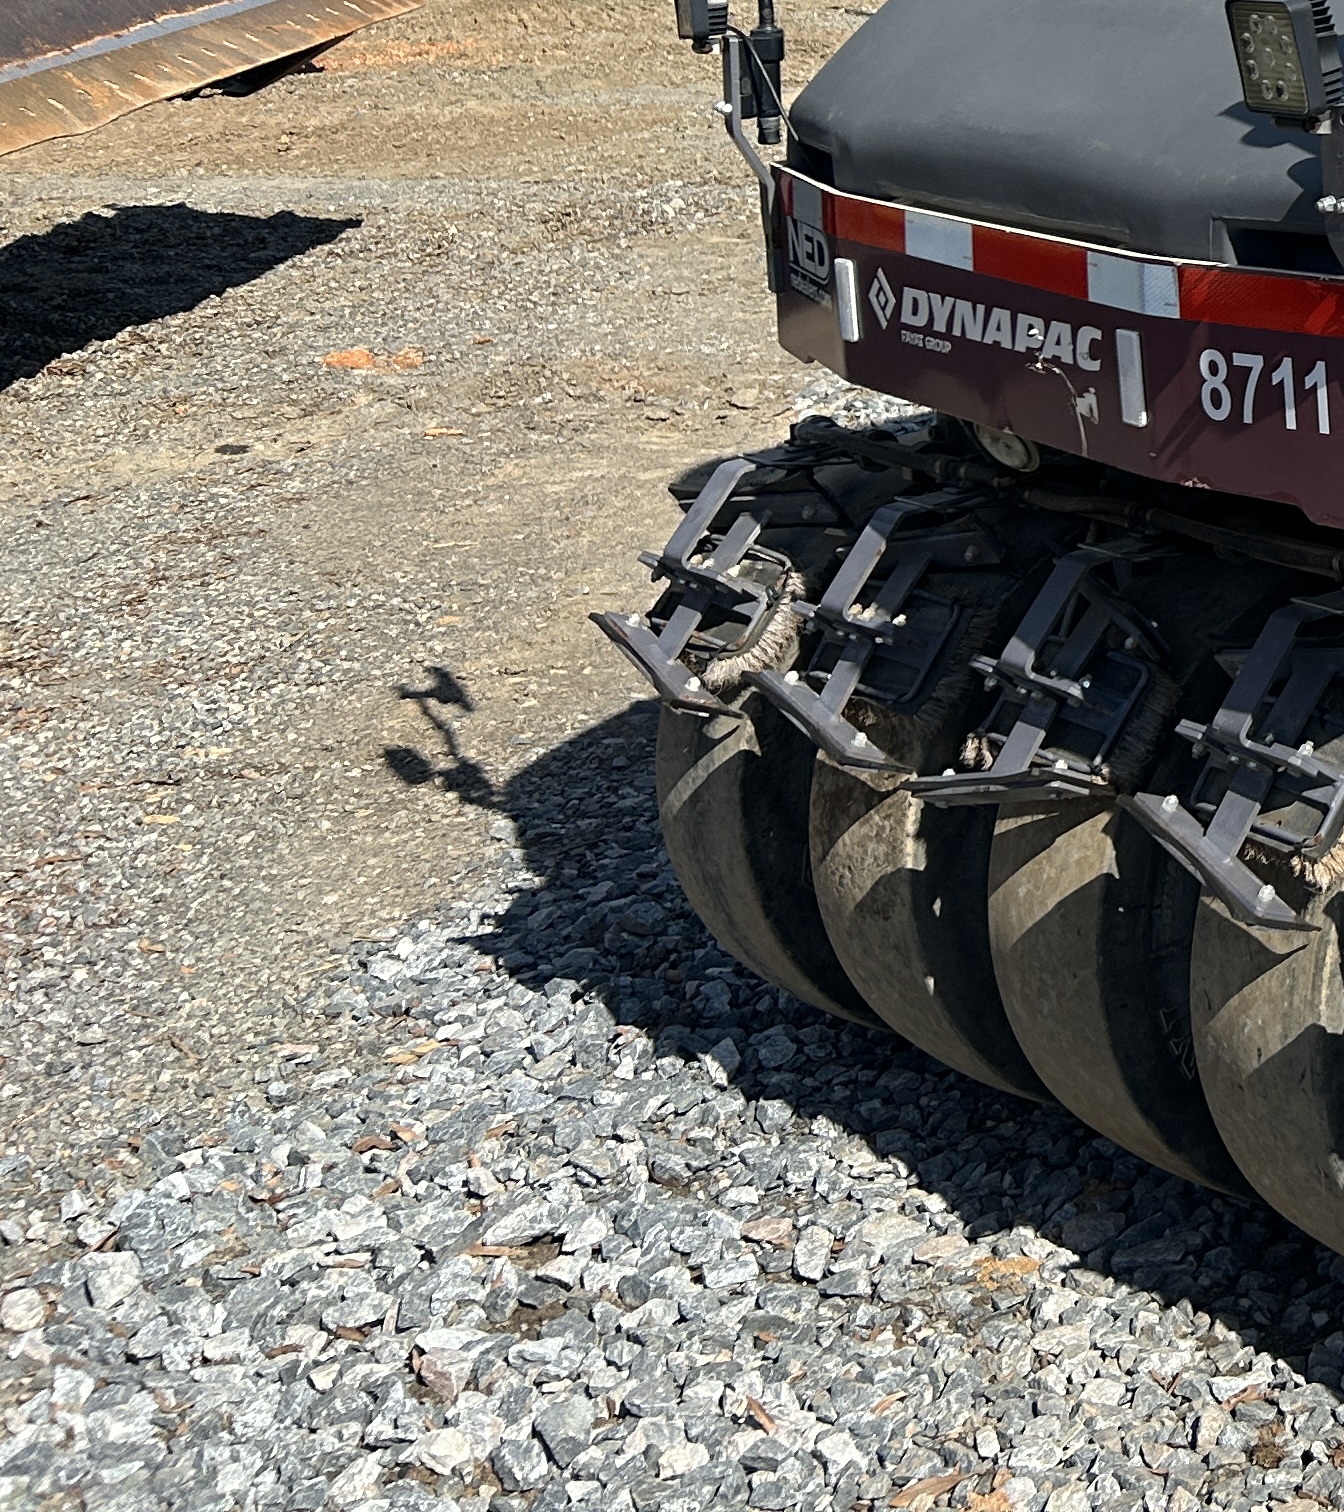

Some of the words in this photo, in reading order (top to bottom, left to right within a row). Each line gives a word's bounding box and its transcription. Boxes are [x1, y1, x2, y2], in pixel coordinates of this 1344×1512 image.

[786, 215, 829, 280] NED
[901, 287, 1102, 372] DYNAPAC
[1199, 349, 1330, 435] 8711
